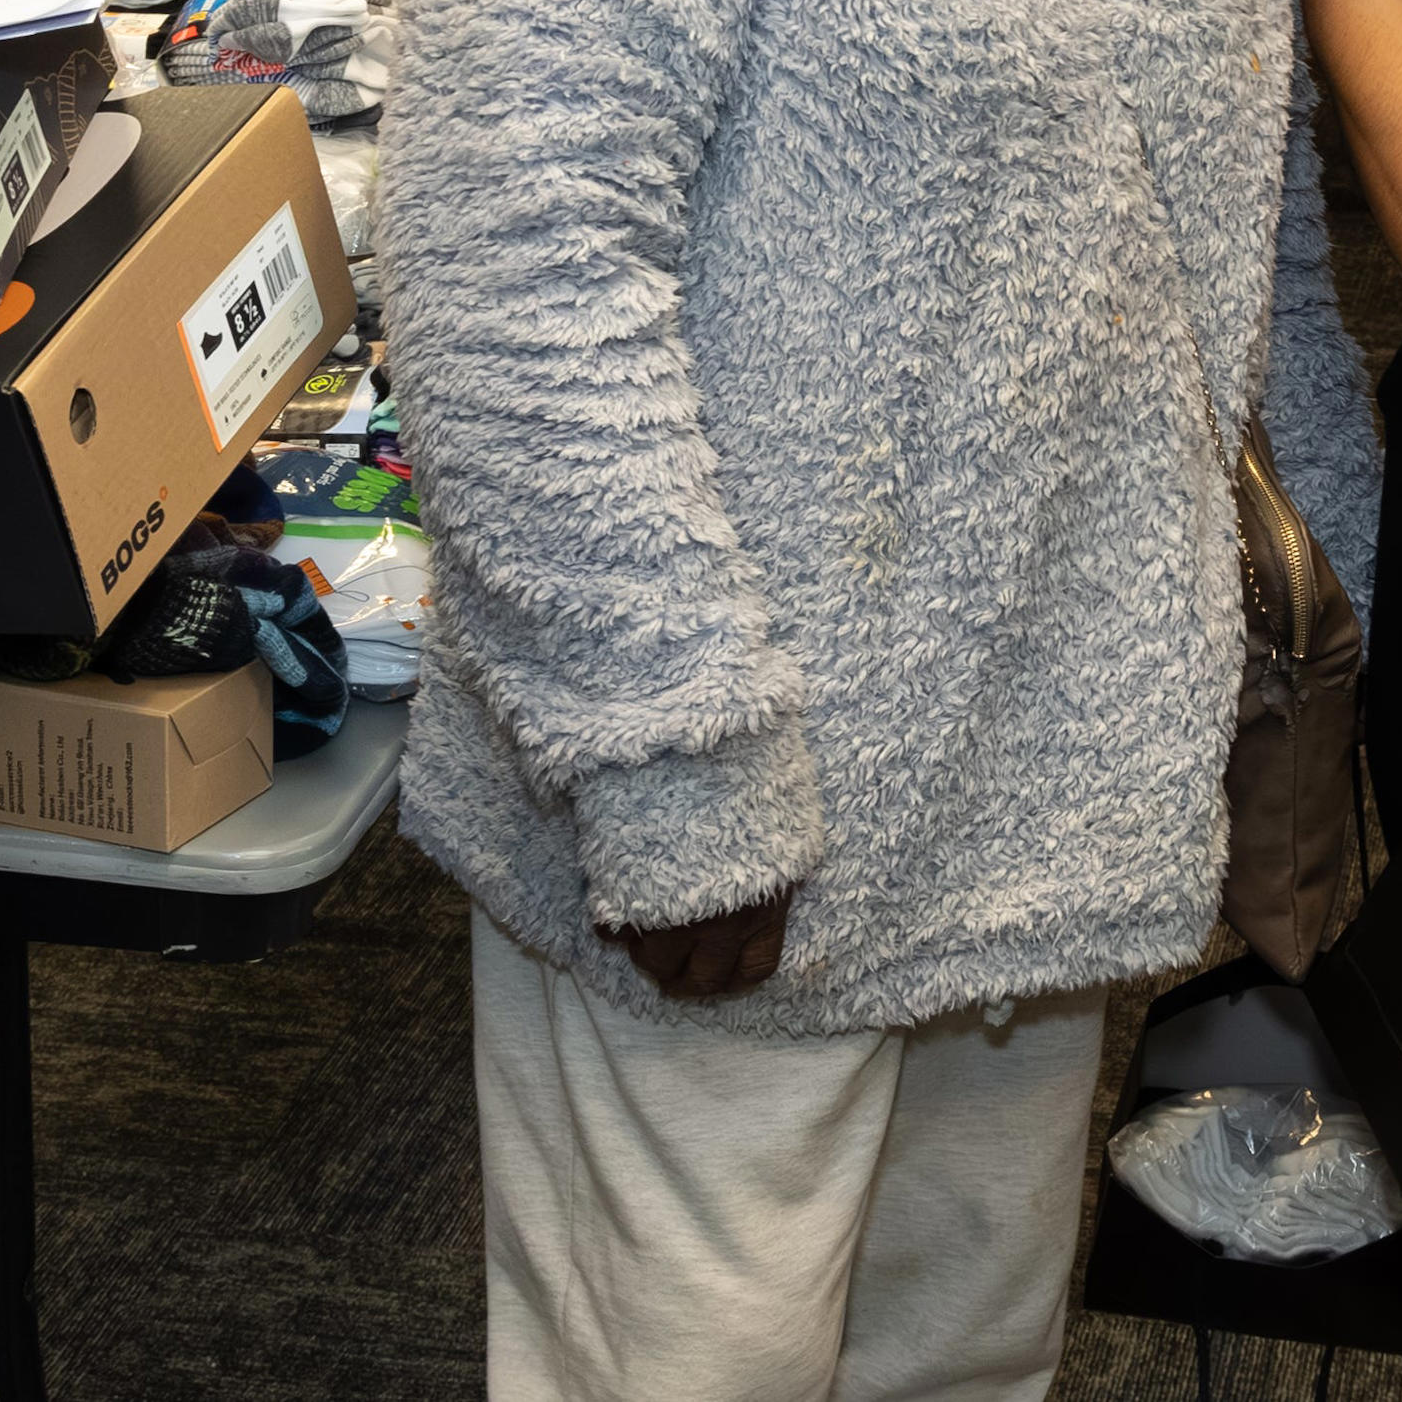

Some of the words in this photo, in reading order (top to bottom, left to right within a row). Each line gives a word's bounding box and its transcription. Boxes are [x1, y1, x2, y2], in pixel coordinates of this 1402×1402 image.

[7, 181, 17, 199] 8
[232, 311, 245, 335] 8
[101, 500, 165, 595] BOGS
